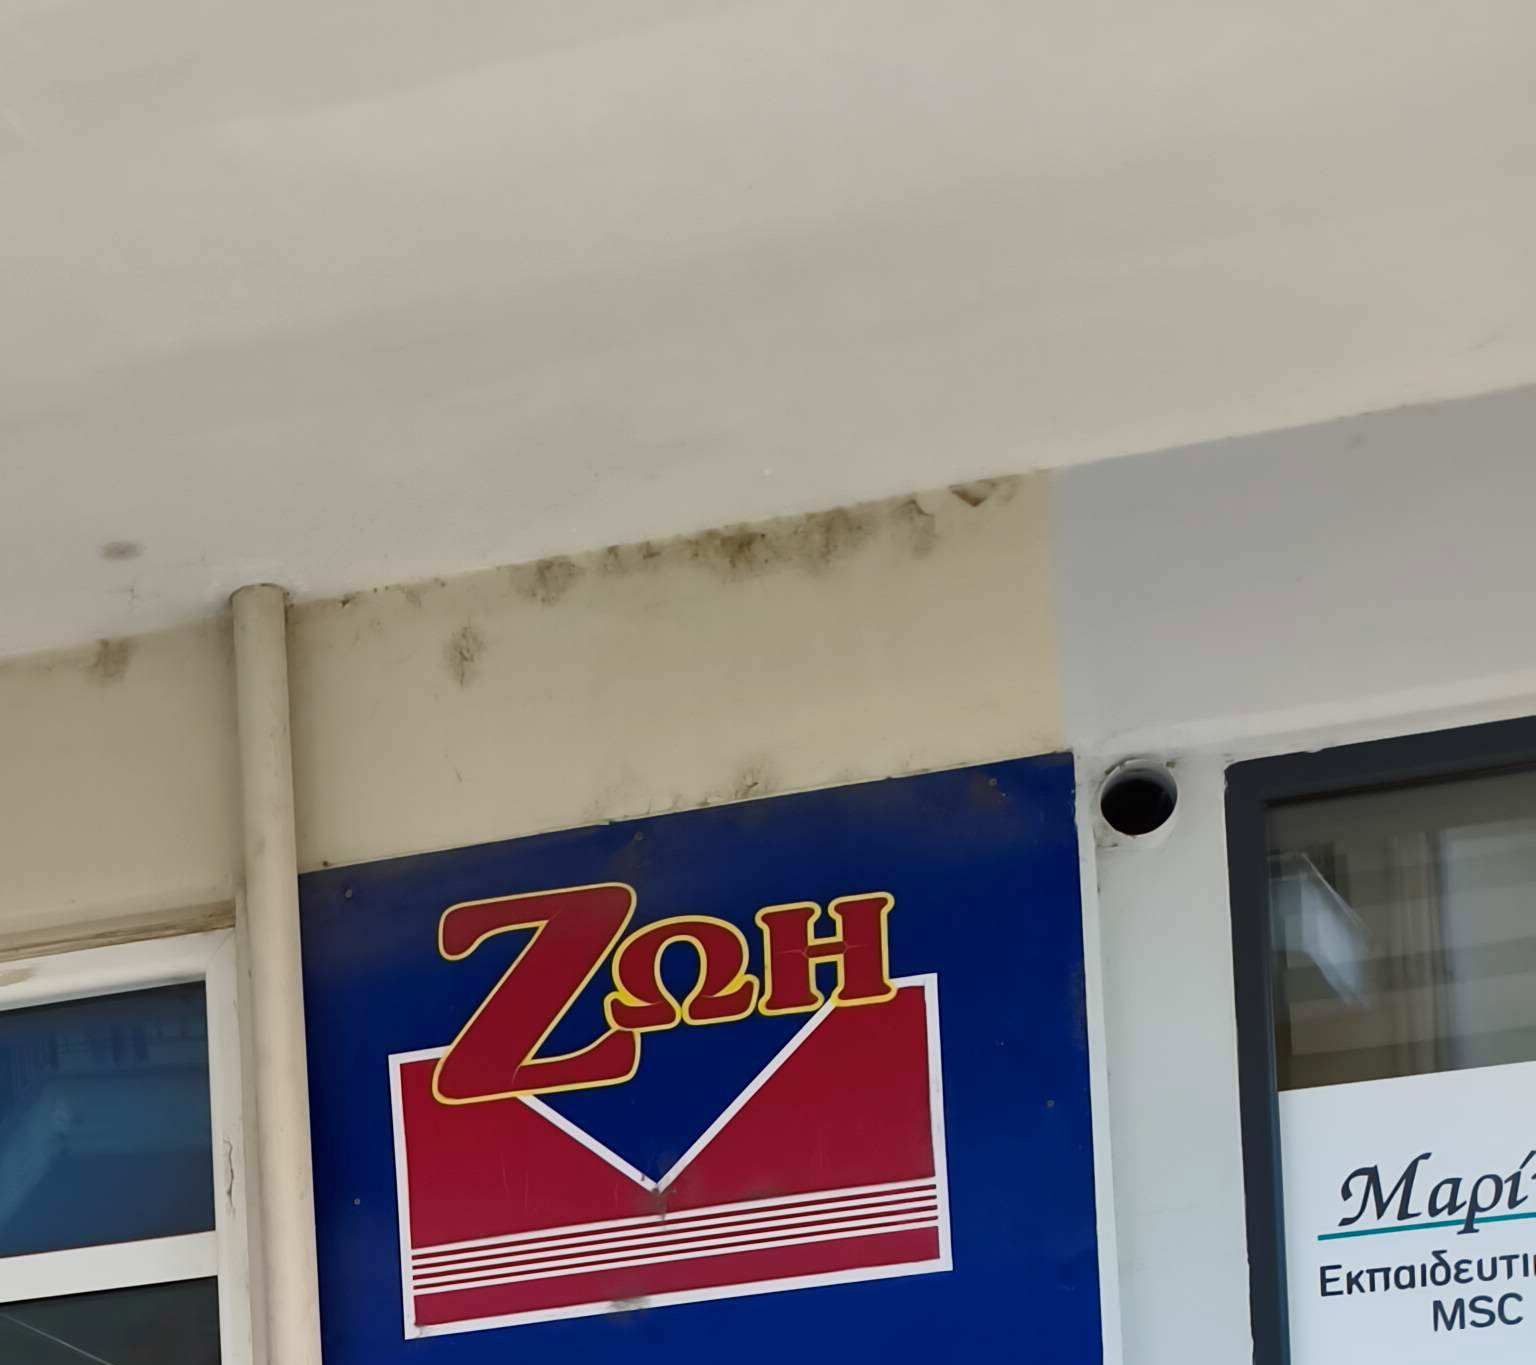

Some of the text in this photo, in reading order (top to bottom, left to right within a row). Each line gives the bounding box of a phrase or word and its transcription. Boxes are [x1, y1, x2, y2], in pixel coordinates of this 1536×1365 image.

[1338, 1150, 1536, 1235] Μαρί
[1319, 1250, 1536, 1297] Εκπαιδευτι
[1432, 1292, 1524, 1332] MSC
